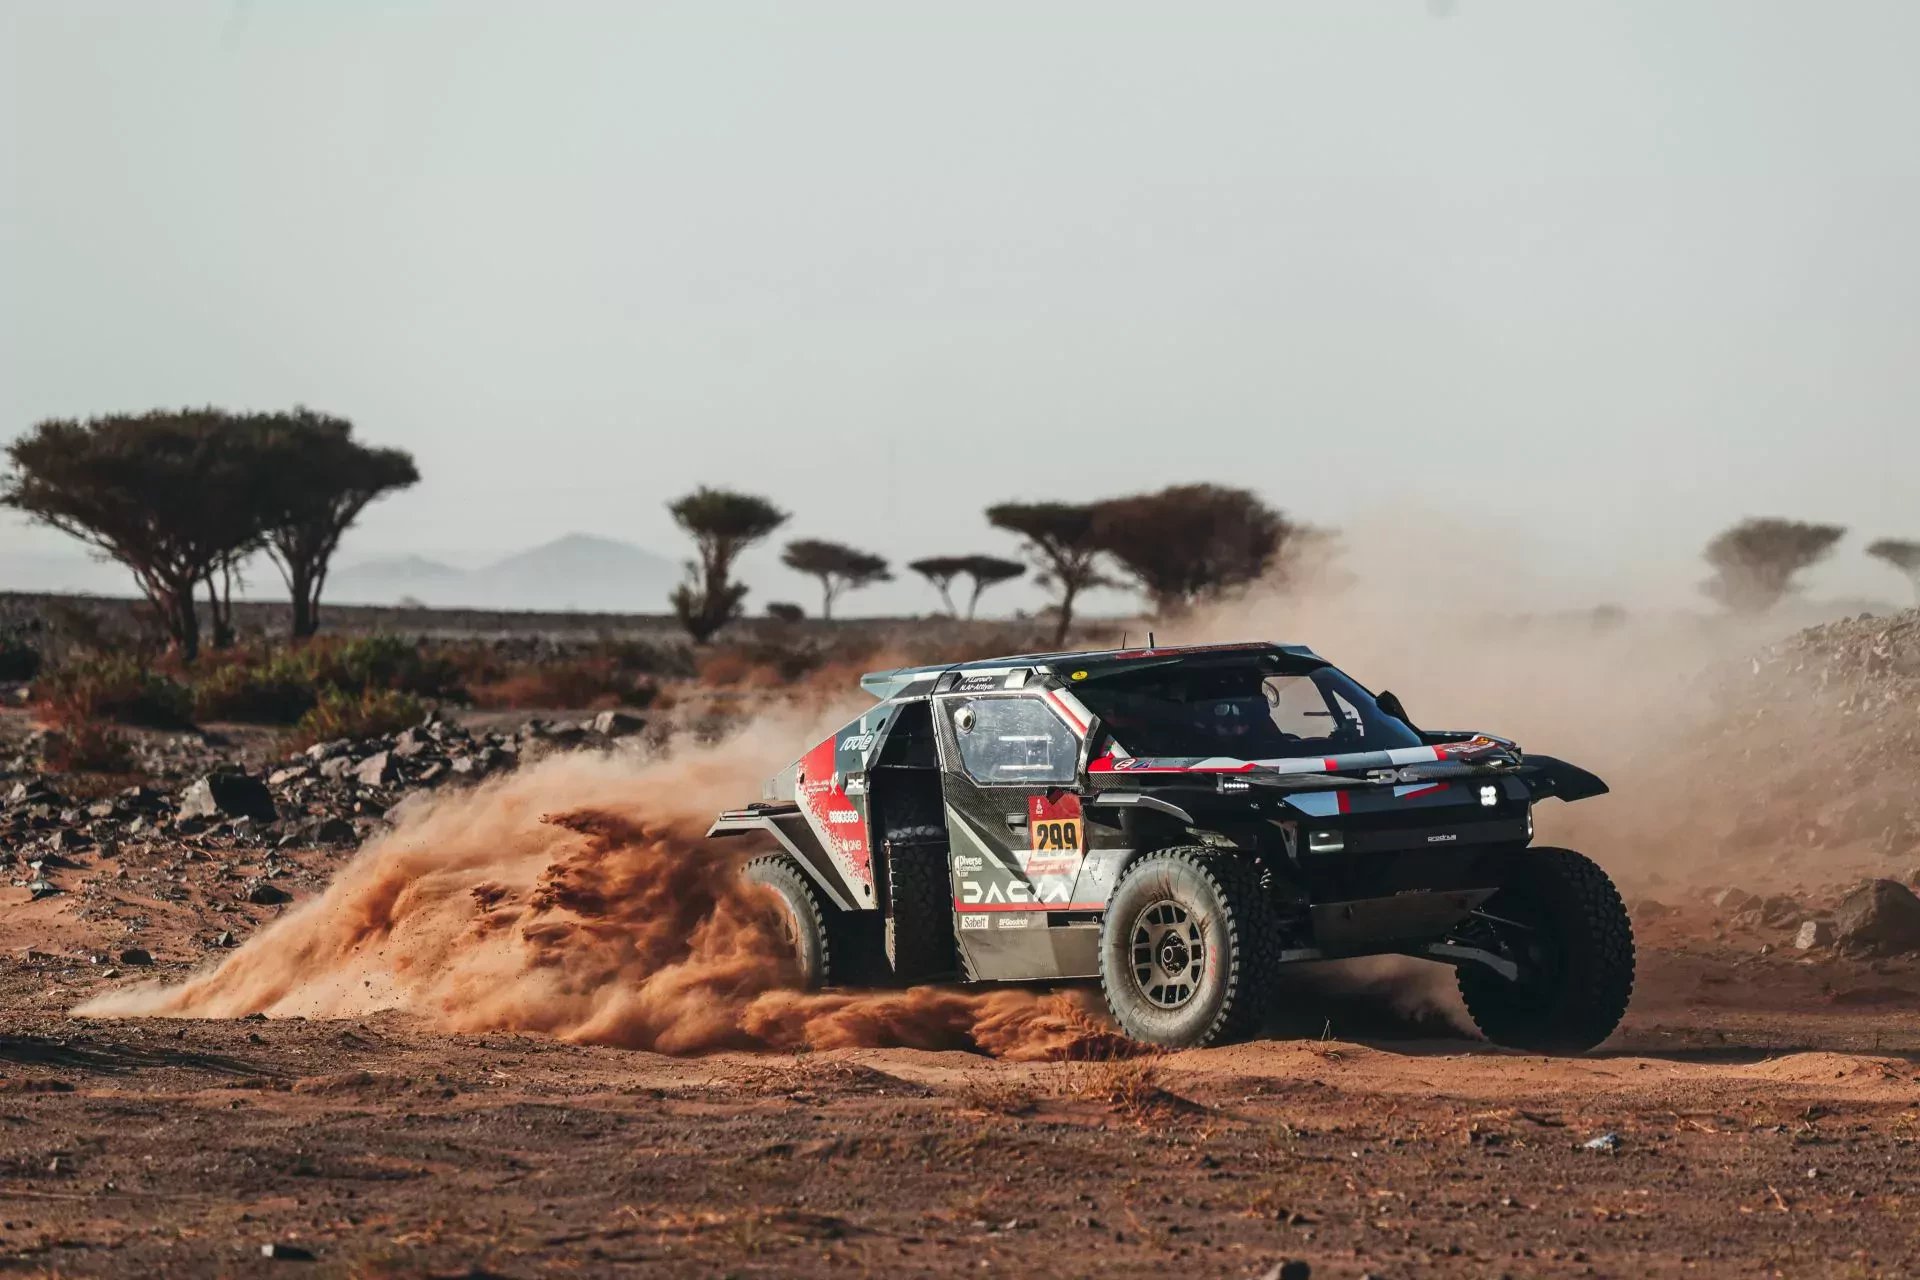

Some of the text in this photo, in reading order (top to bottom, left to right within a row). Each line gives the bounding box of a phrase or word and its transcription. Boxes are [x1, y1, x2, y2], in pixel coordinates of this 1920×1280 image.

[848, 839, 862, 851] QNB
[1036, 822, 1078, 857] 299
[962, 881, 1071, 903] DACIA
[964, 916, 987, 928] Sabelt
